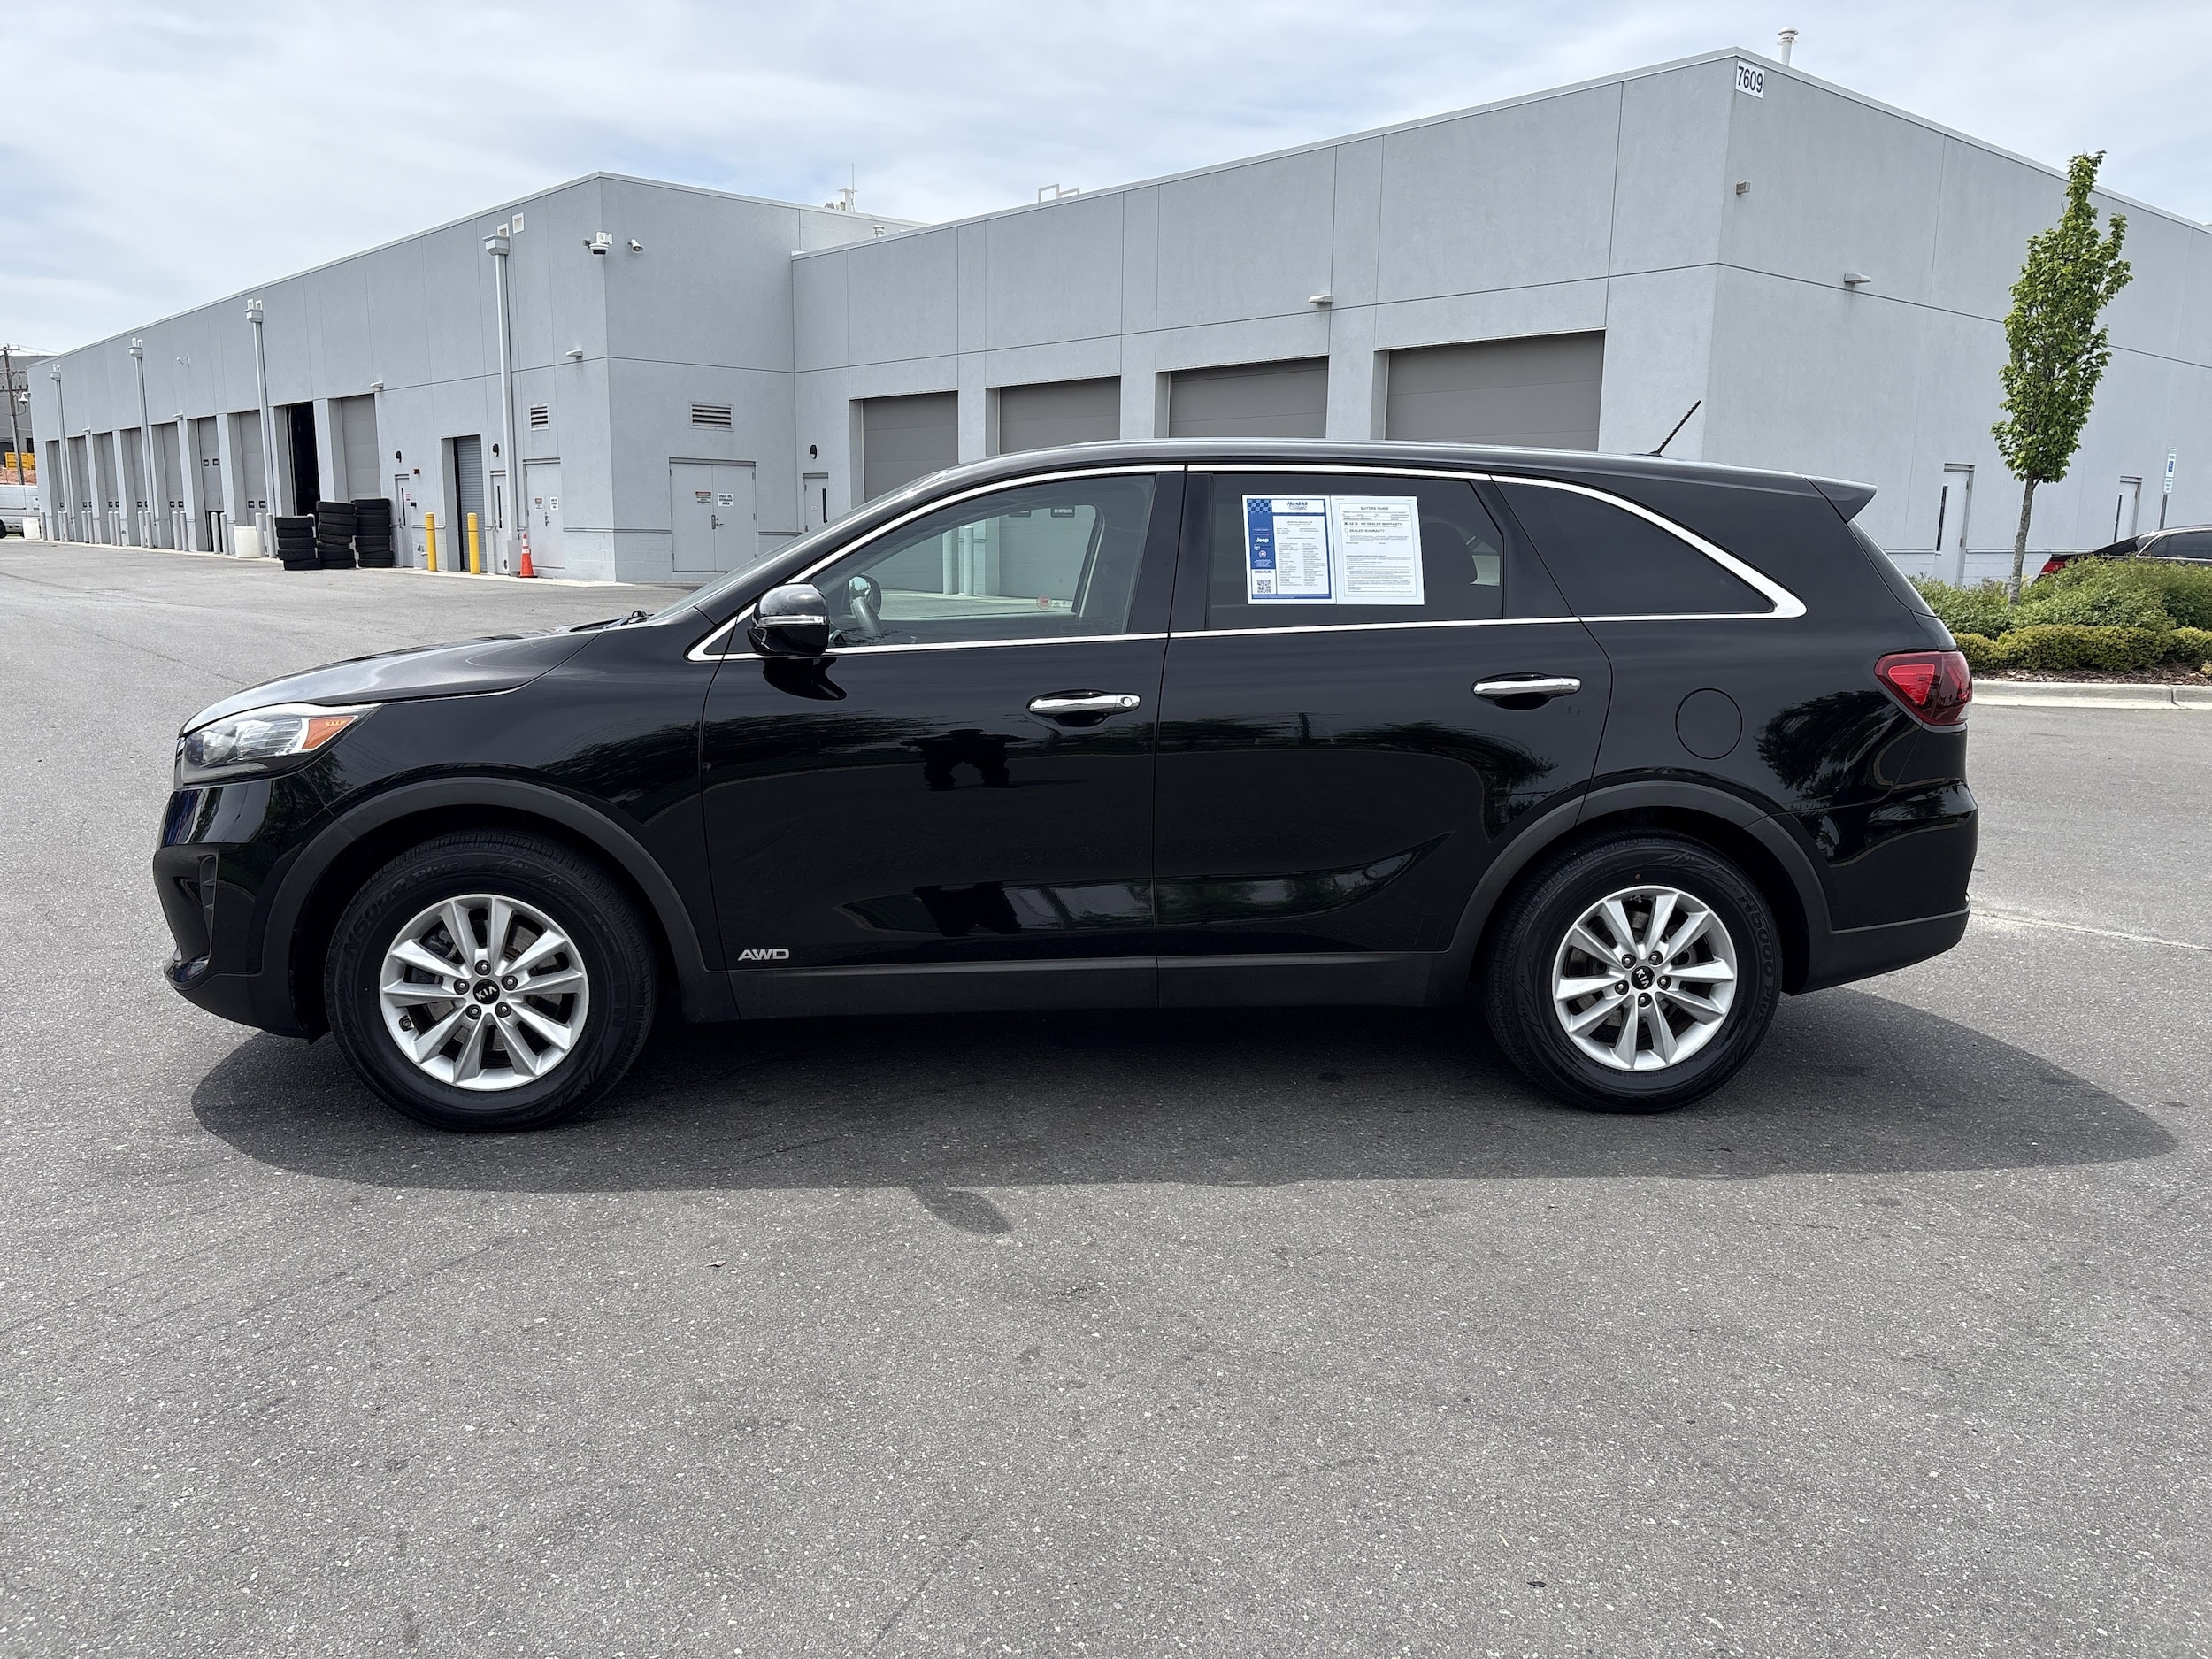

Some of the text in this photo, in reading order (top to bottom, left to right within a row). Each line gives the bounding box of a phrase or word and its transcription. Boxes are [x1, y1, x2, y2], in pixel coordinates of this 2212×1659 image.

[1738, 65, 1763, 93] 7609
[737, 949, 789, 961] AWD
[1636, 968, 1650, 988] KIA
[475, 985, 497, 1001] KIA
